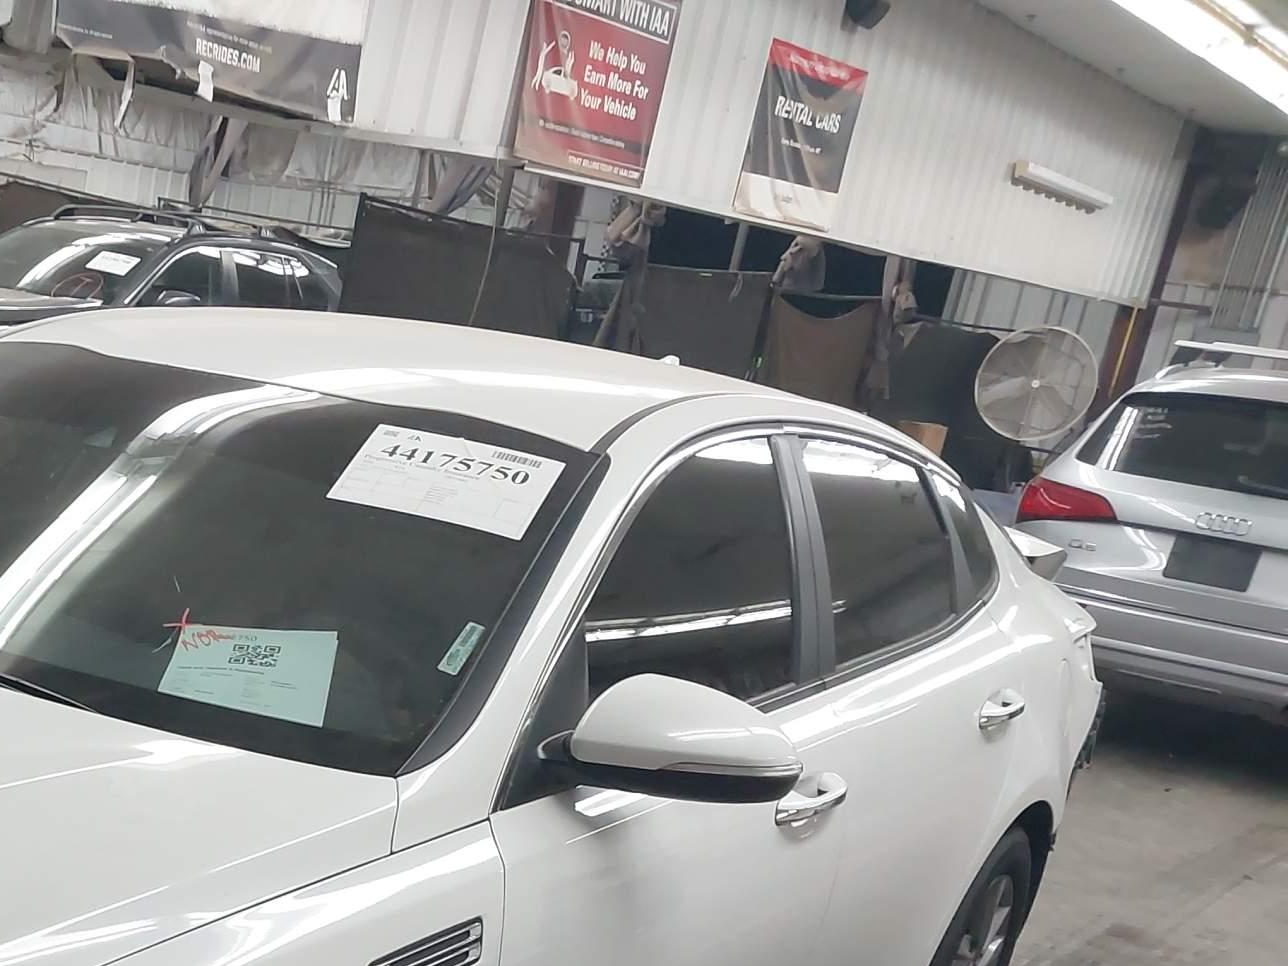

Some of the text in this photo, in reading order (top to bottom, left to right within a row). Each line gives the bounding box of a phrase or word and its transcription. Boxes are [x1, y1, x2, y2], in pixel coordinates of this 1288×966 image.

[619, 0, 651, 29] WITH
[649, 6, 670, 37] IAA
[195, 37, 261, 73] RECRIDES.COM
[589, 40, 647, 75] We Help You
[584, 64, 649, 100] Earn More For
[580, 88, 637, 121] Your Vehicle
[815, 111, 842, 134] CARS
[380, 444, 531, 485] 44175750
